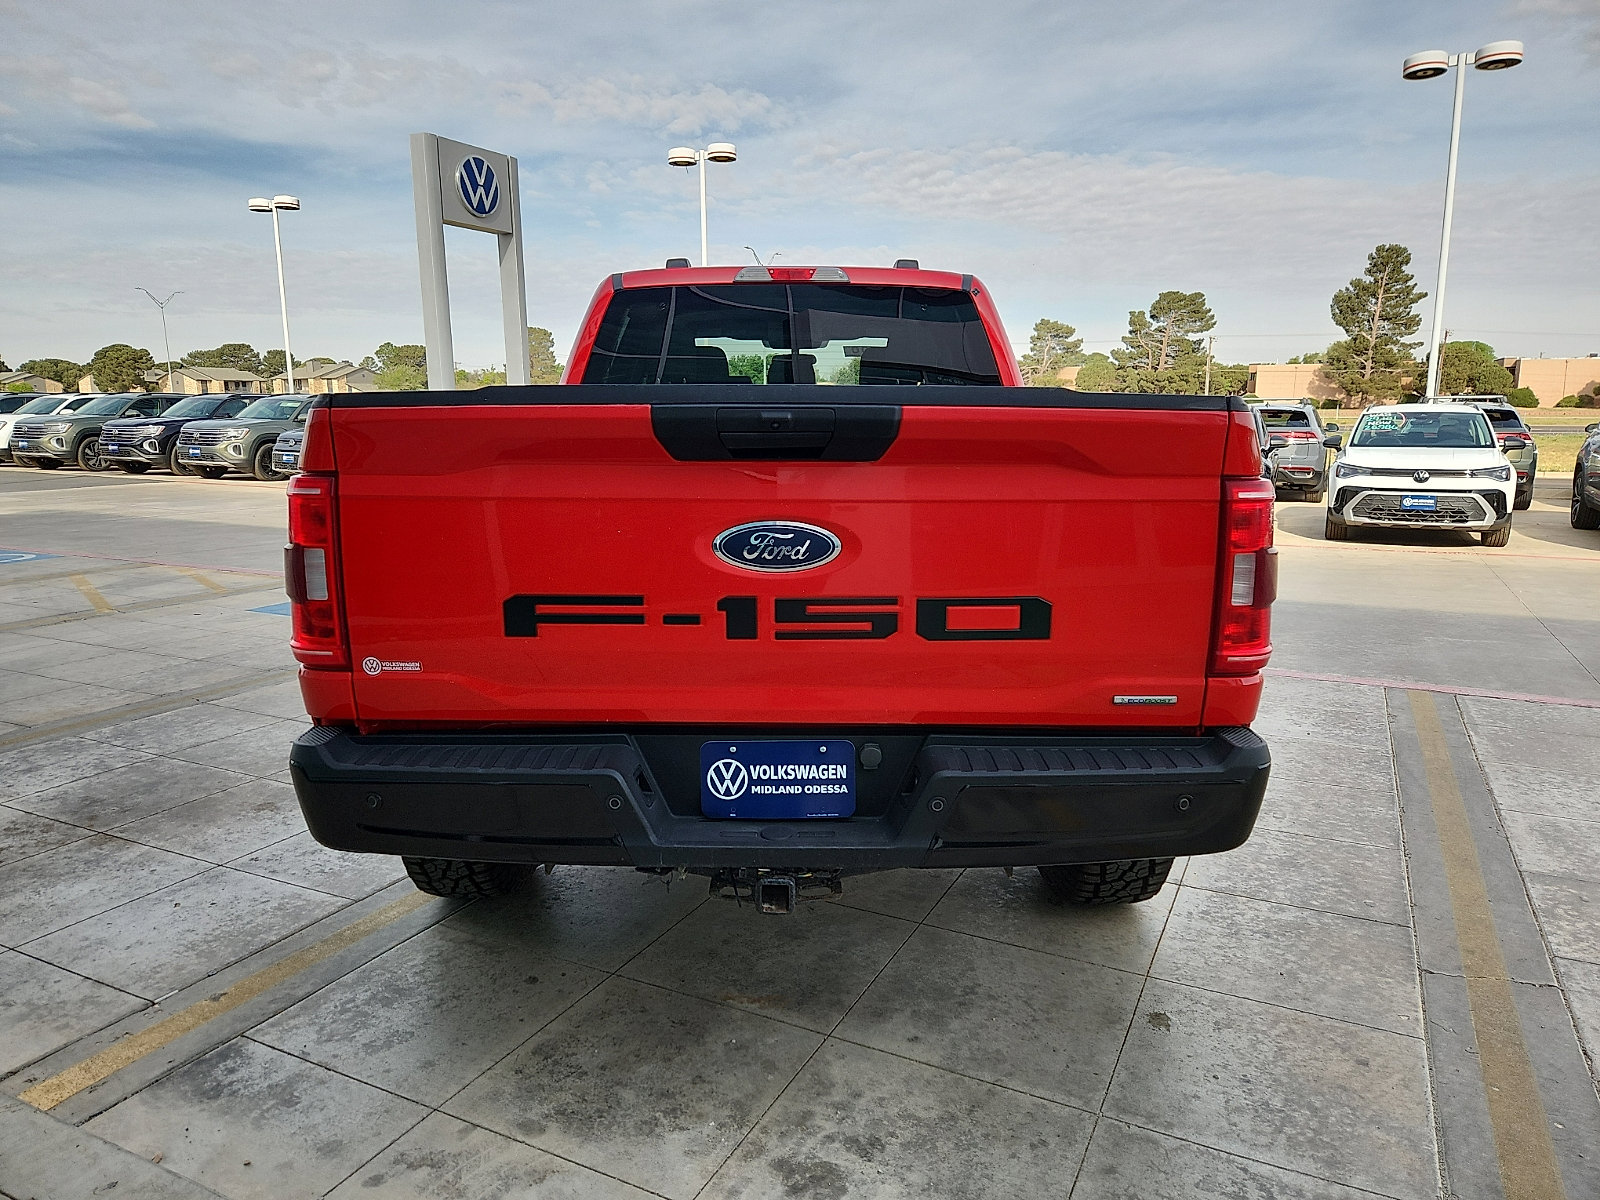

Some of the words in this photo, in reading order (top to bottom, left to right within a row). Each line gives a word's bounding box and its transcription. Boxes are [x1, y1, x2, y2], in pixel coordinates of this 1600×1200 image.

[457, 155, 499, 217] VW
[742, 531, 811, 560] Ford
[503, 593, 1053, 641] F-150
[750, 764, 847, 780] VOLKSWAGEN
[751, 785, 802, 794] MIDLAND
[804, 784, 849, 794] ODESSA
